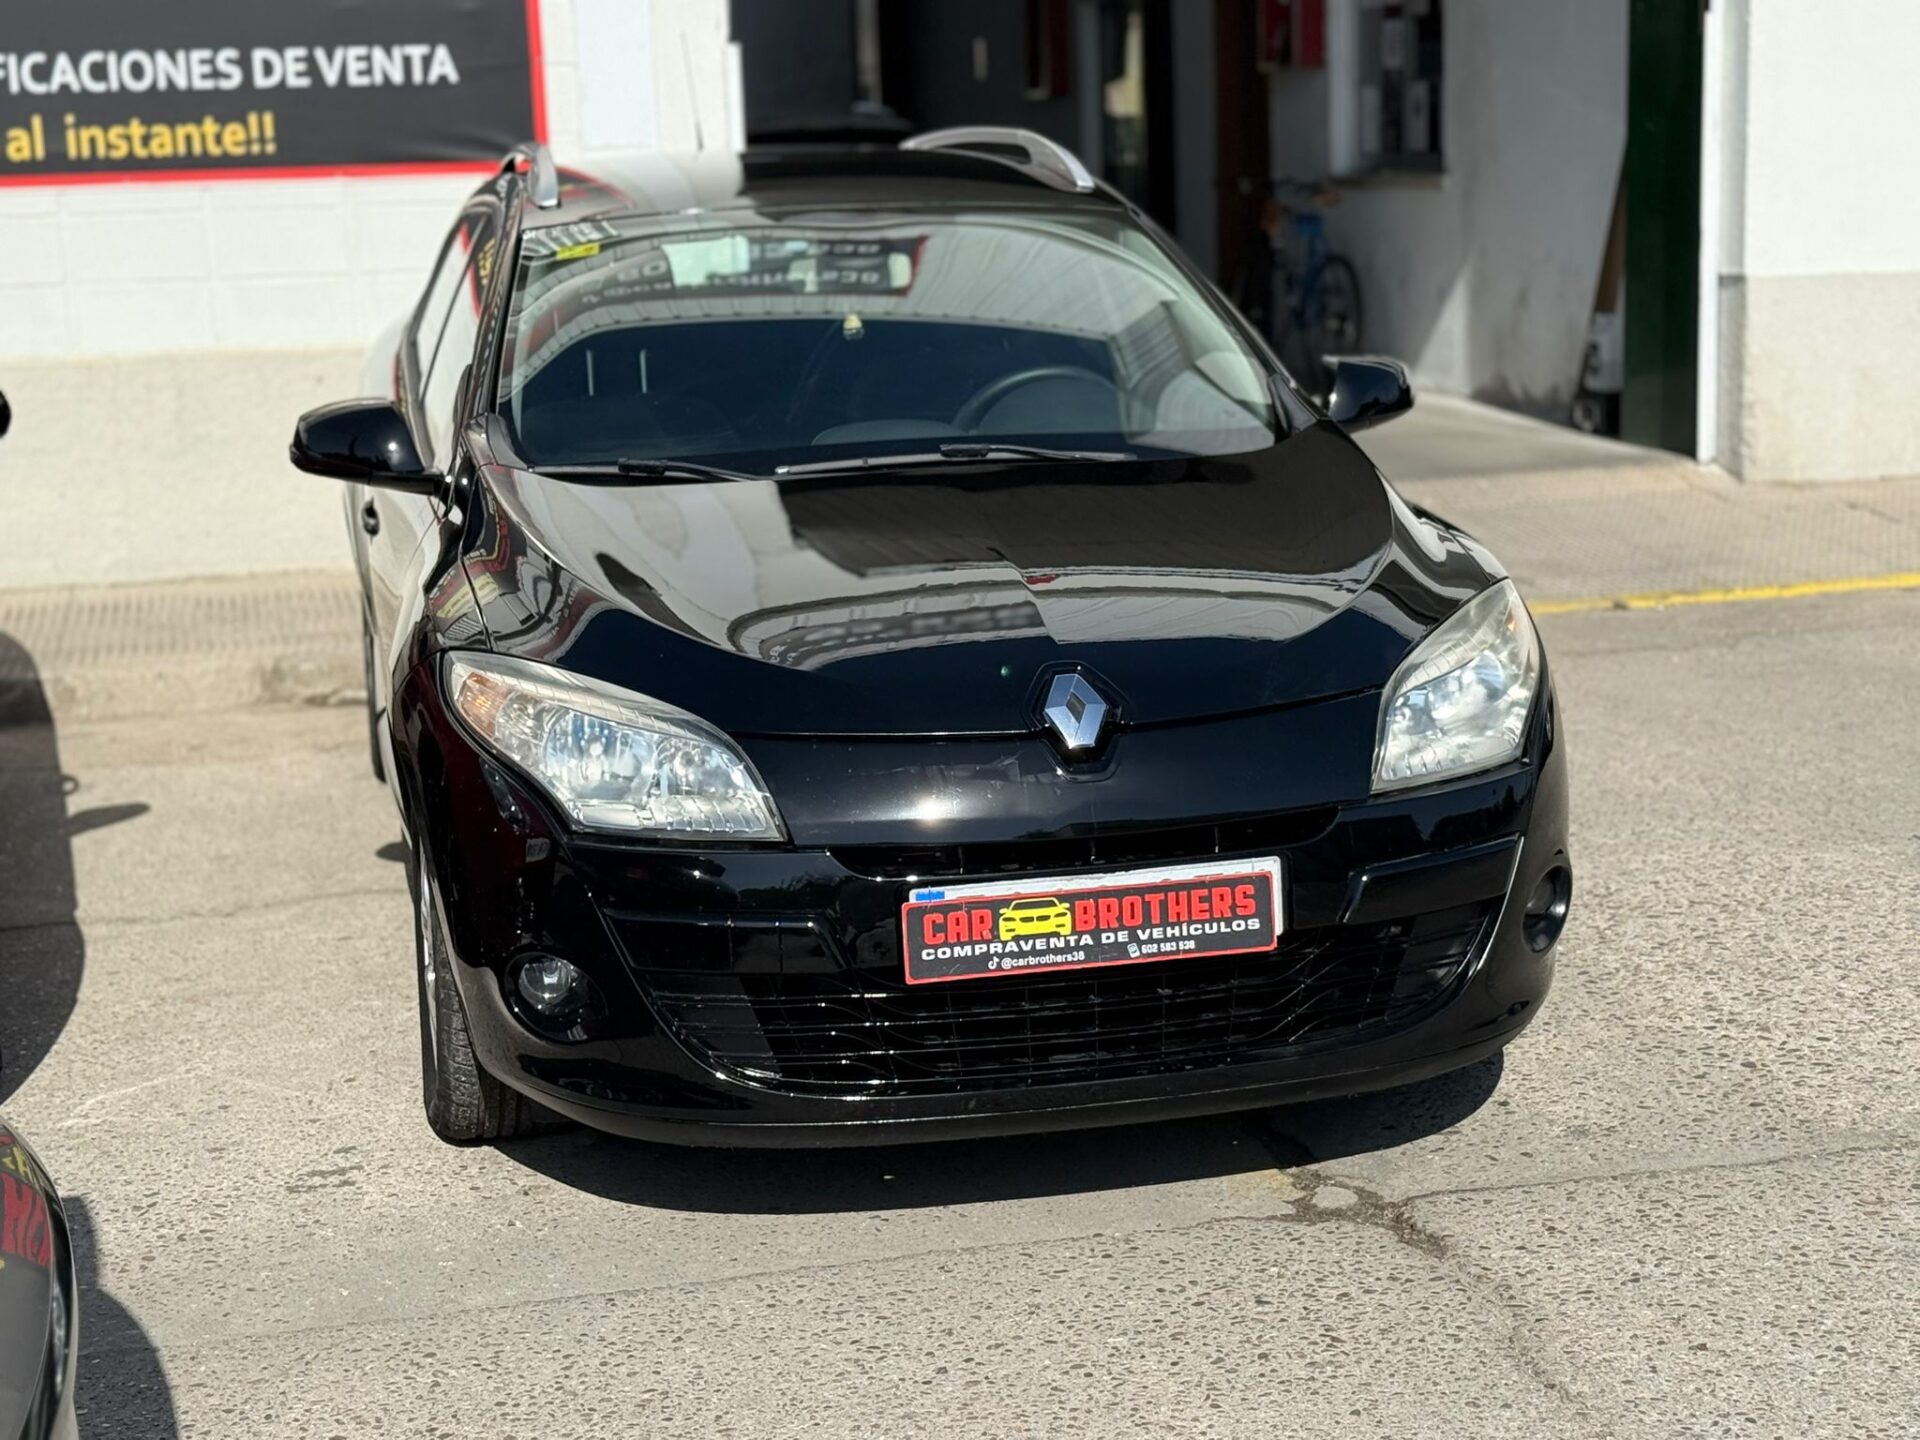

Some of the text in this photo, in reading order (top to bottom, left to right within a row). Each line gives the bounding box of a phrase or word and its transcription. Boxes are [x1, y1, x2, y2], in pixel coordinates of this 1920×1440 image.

[251, 47, 312, 89] DE
[314, 44, 460, 87] VENTA
[5, 111, 277, 162] al instante!!
[923, 884, 1257, 945] CAR BROTHERS
[921, 917, 1261, 961] COMPRAVENTA DE VEHÍCULOS
[1001, 950, 1086, 970] @carbrothers38
[1141, 943, 1159, 954] 602
